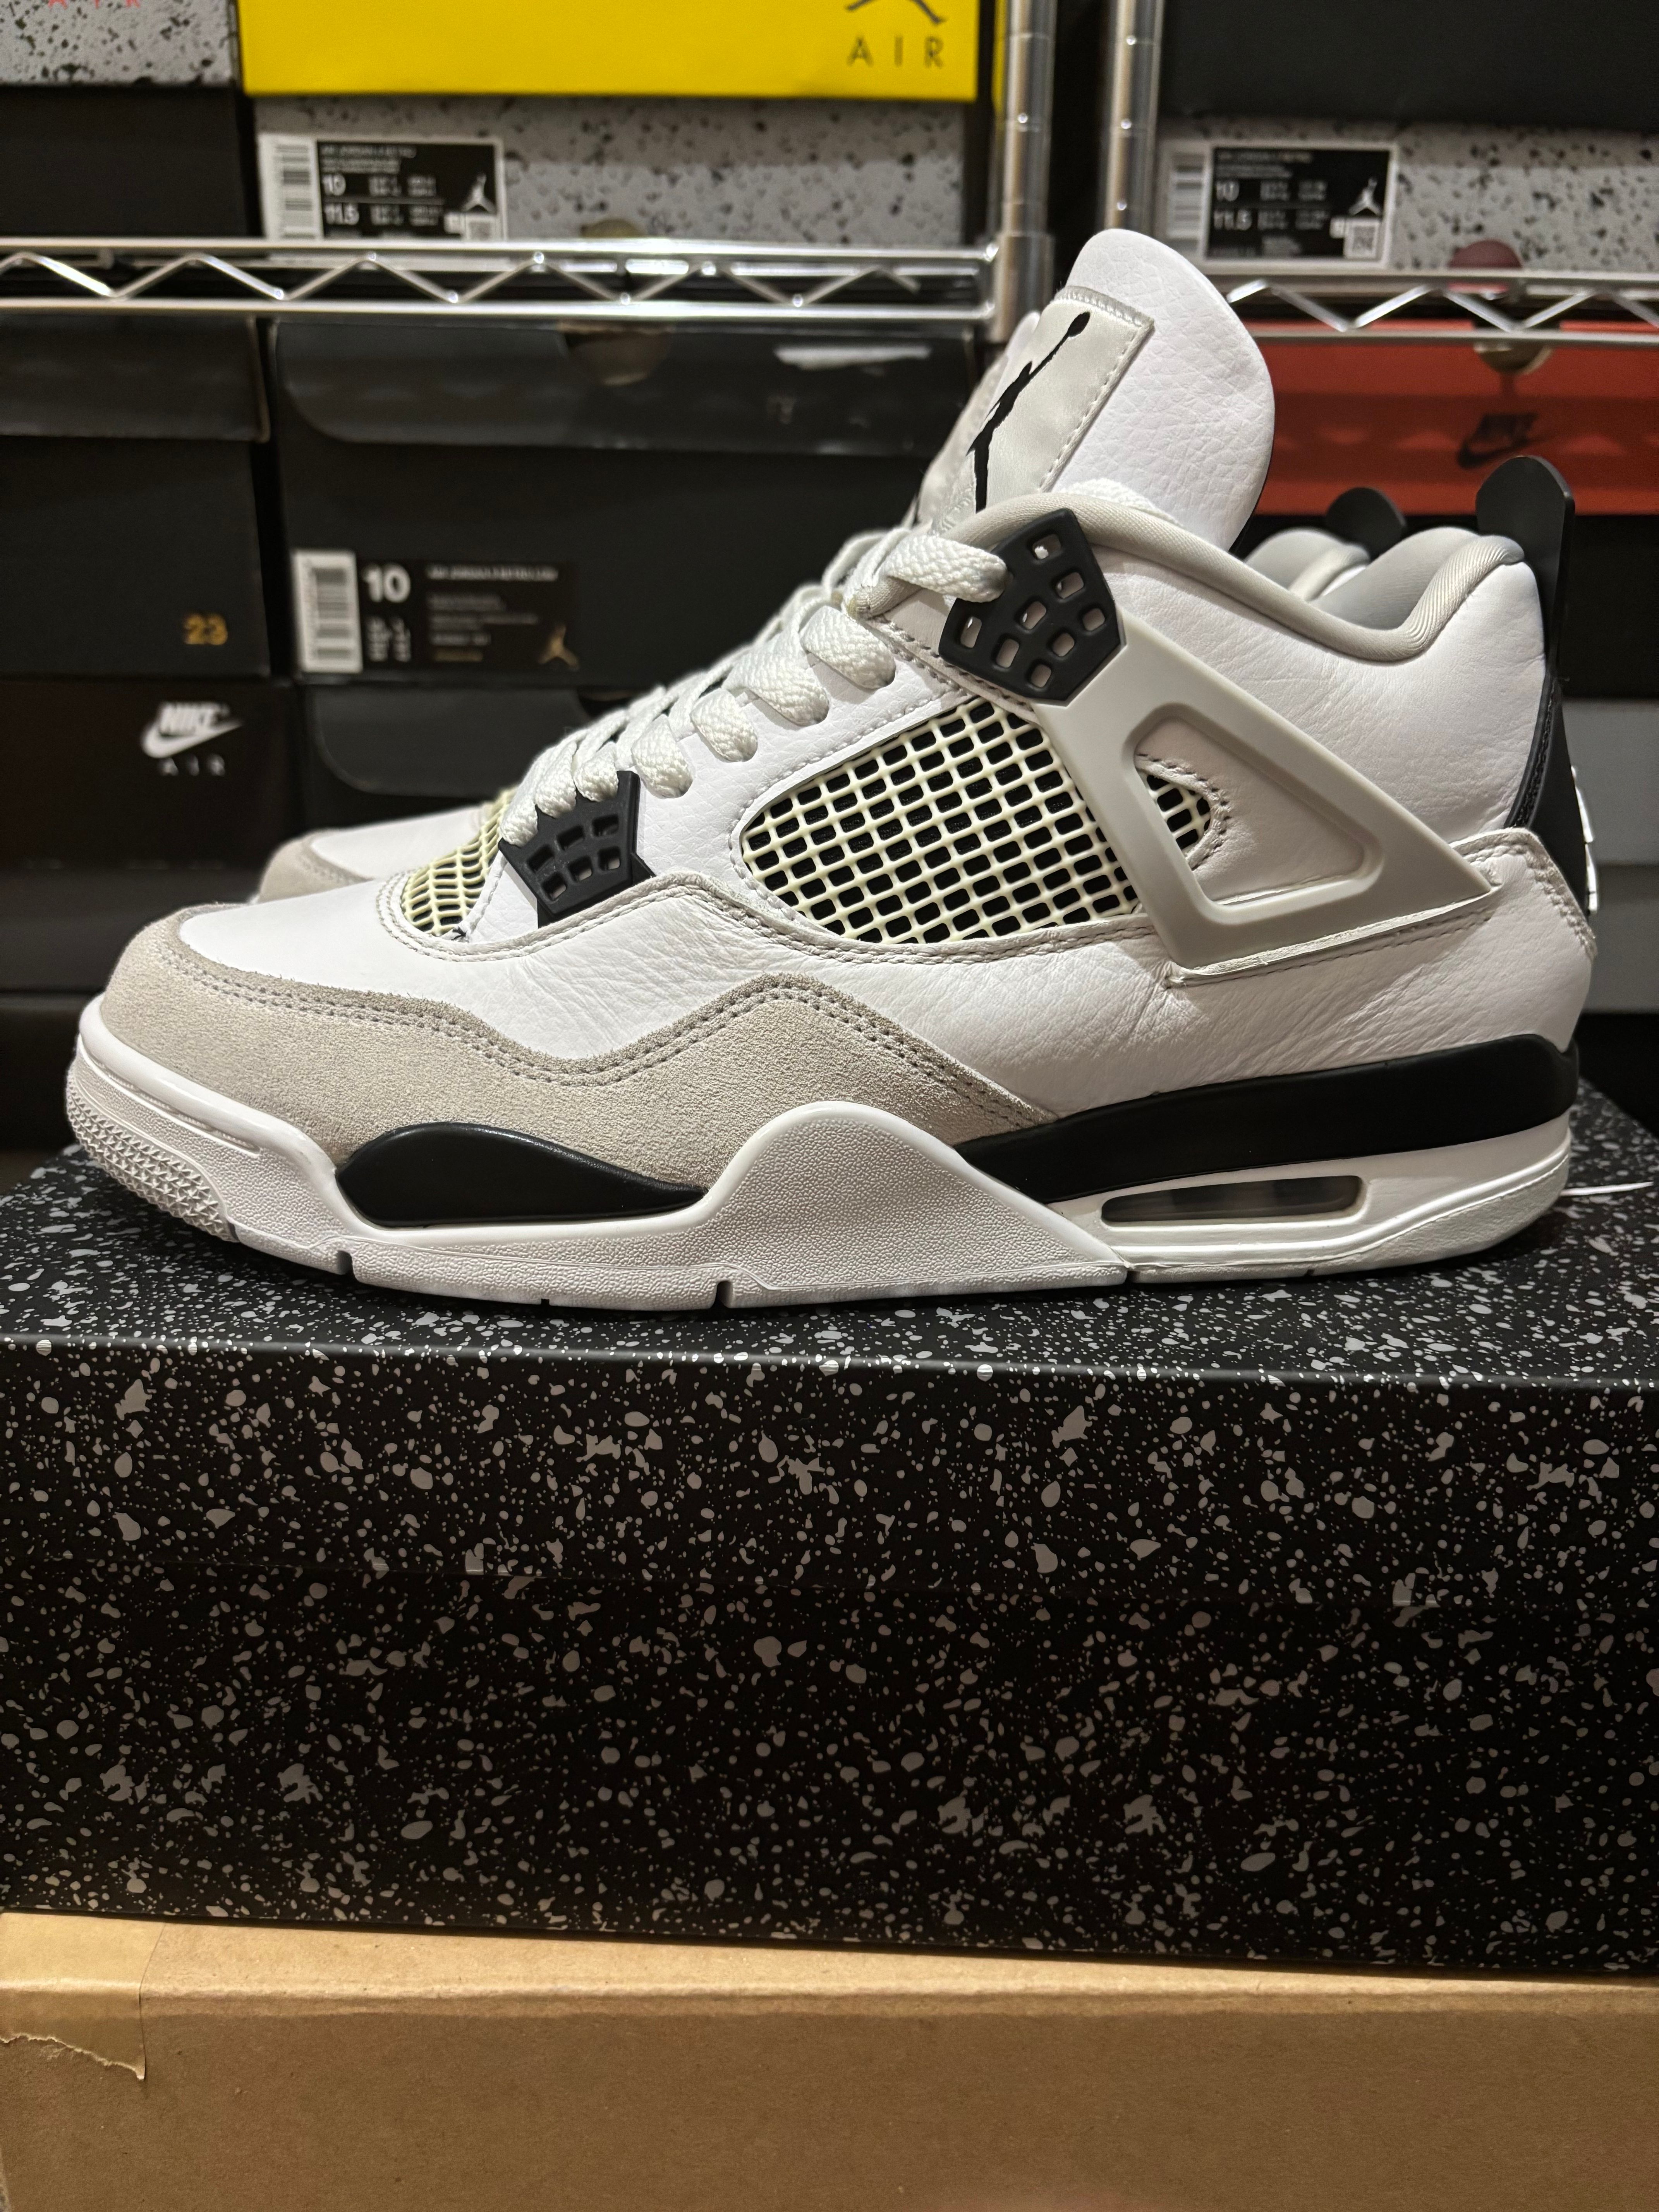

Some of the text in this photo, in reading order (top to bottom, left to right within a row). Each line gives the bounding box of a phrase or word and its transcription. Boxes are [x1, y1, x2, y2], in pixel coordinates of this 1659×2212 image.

[846, 34, 944, 68] AIR
[322, 174, 346, 196] 10
[1216, 181, 1240, 202] 10
[363, 562, 411, 603] 10
[184, 613, 228, 646] 23
[159, 701, 221, 735] NIKE
[159, 754, 225, 776] AIR
